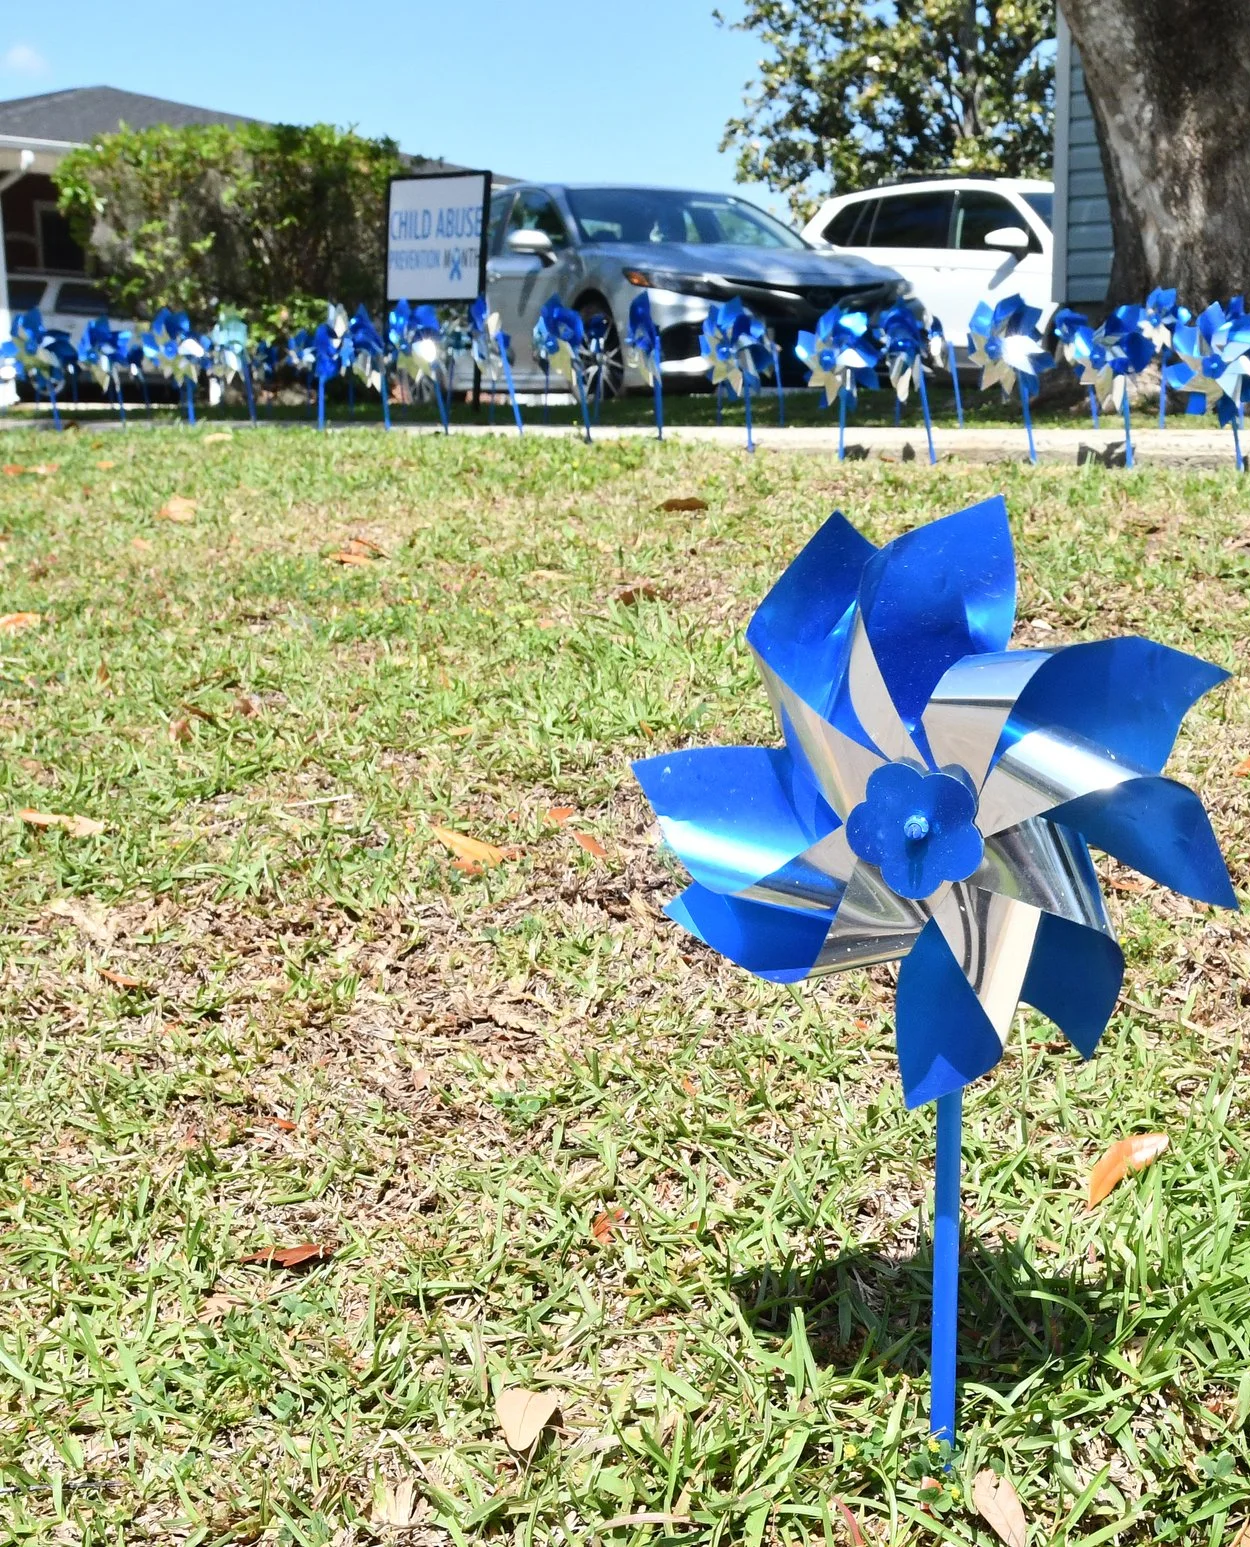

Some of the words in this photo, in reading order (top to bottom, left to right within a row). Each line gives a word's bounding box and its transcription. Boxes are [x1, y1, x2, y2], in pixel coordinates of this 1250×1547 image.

[391, 208, 431, 240] CHILD
[436, 205, 482, 238] ABUSE
[389, 249, 440, 270] PREVENTION
